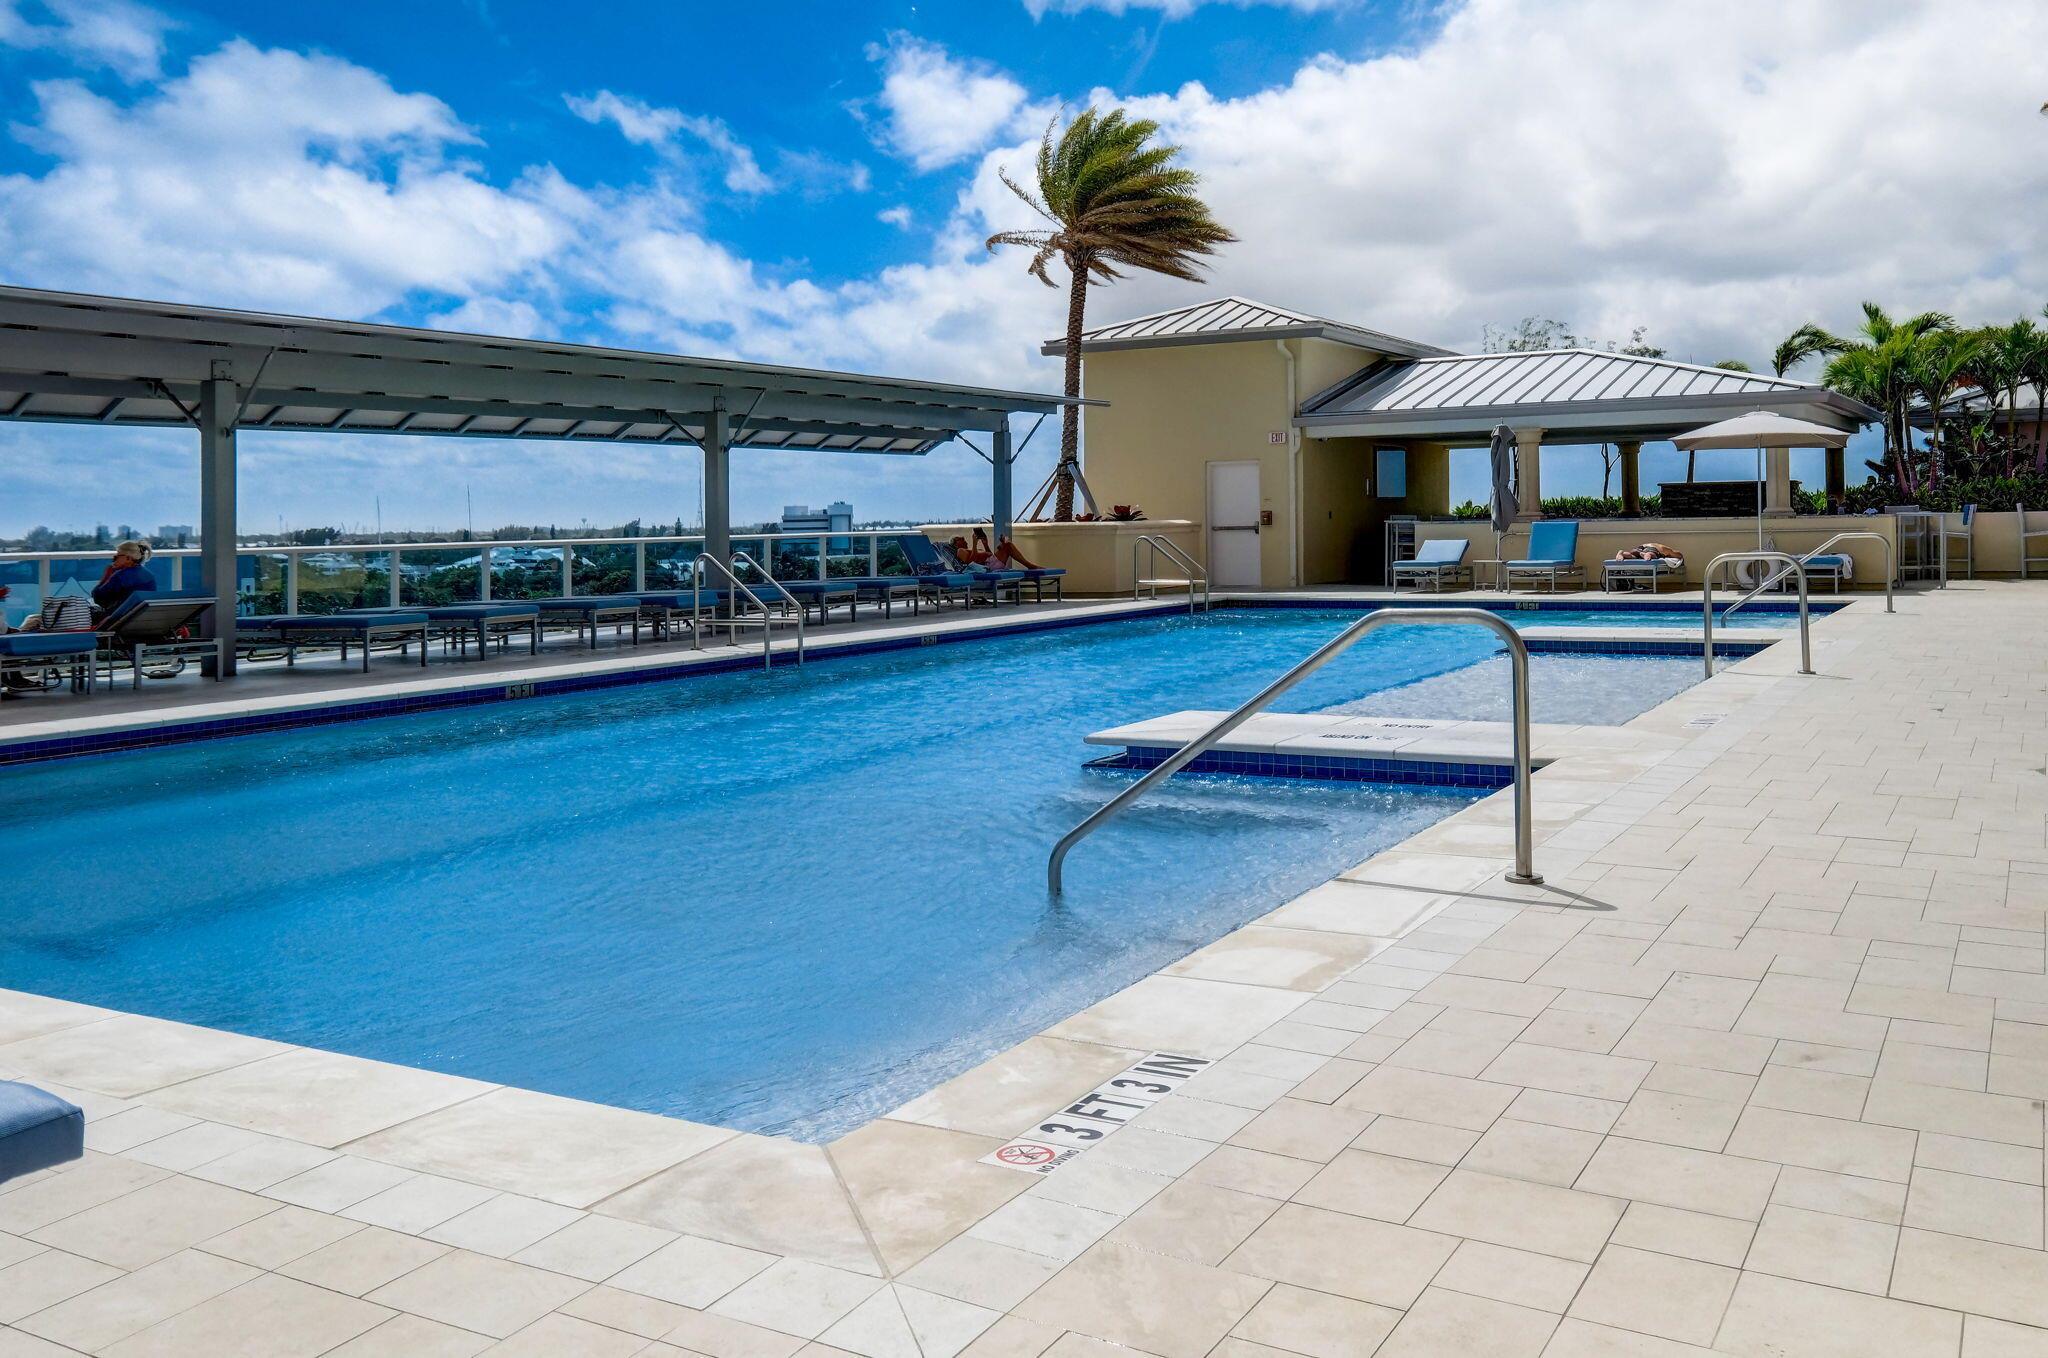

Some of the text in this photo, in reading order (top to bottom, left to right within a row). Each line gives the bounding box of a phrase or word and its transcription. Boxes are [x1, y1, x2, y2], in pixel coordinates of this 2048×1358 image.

[1039, 1053, 1211, 1140] 3 FT 3 IN
[1036, 1149, 1080, 1173] NO DIVING
